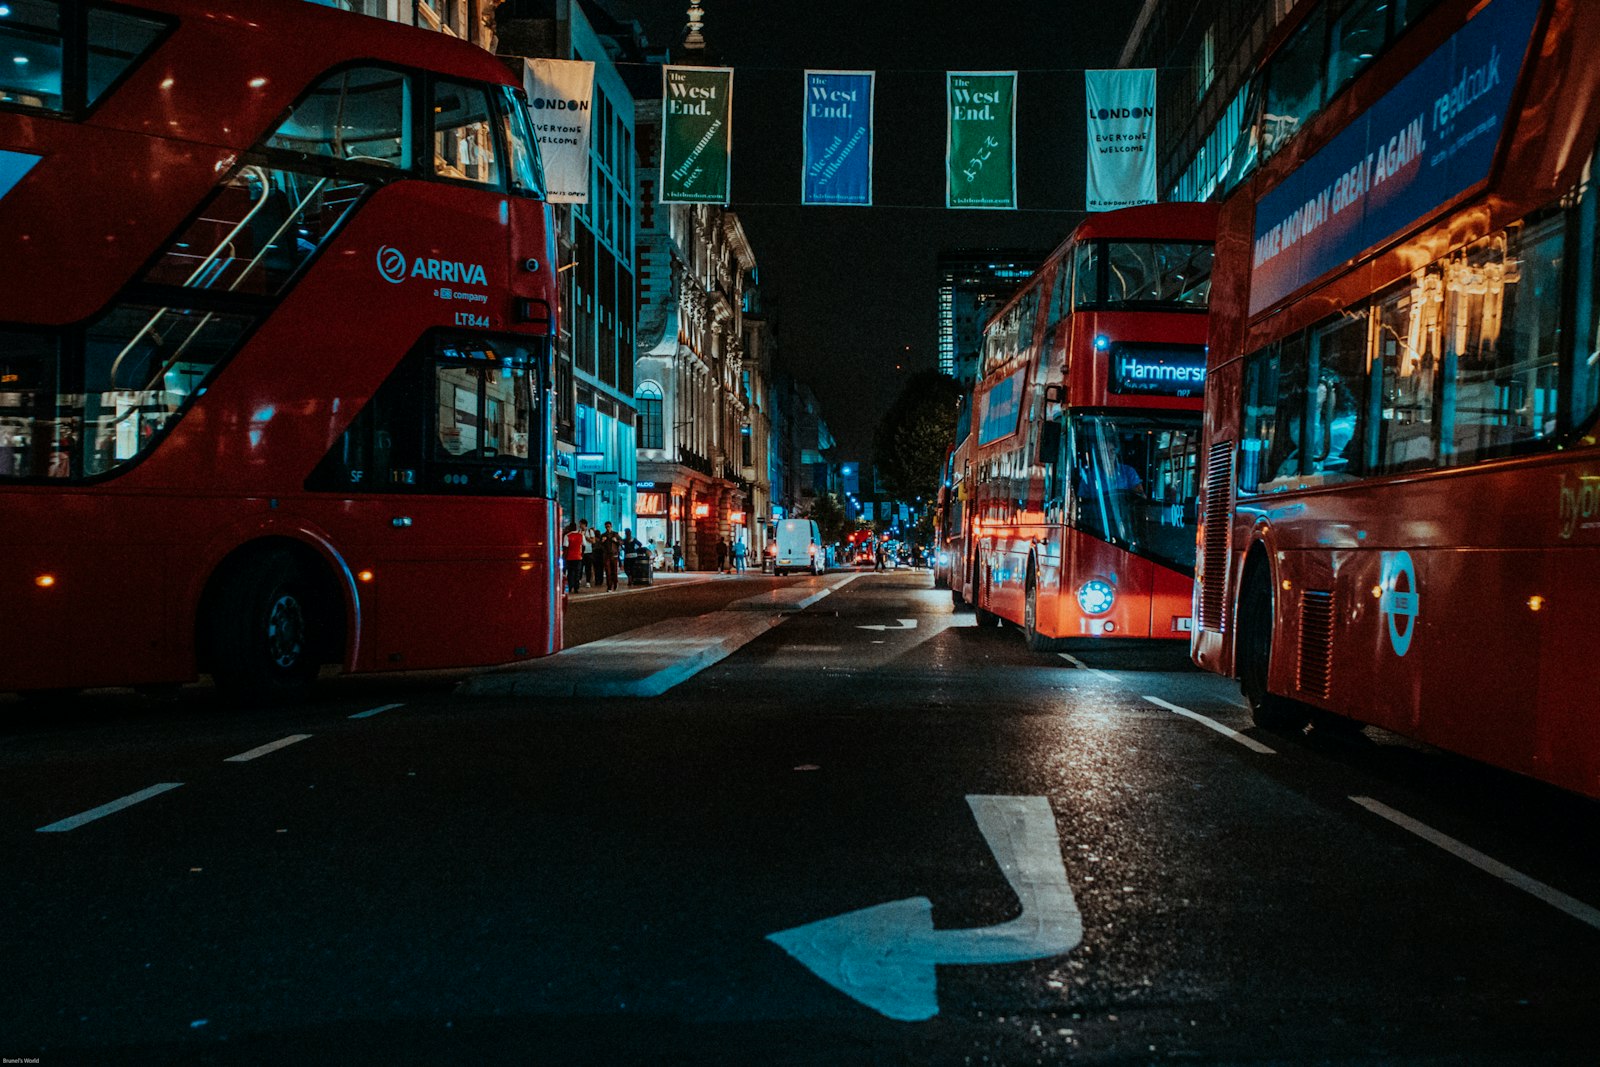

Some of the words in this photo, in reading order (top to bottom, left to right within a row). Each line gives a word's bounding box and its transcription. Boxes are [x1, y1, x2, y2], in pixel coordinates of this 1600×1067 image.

[670, 83, 716, 99] West
[812, 87, 857, 102] West
[954, 89, 1000, 104] West
[670, 99, 712, 116] End.
[811, 103, 852, 119] End.
[954, 105, 995, 120] End.
[1090, 107, 1153, 120] LONDON
[1096, 132, 1147, 142] EVERYONE
[809, 159, 827, 177] Alle
[824, 135, 842, 159] sind
[819, 126, 866, 185] willkommen
[1100, 145, 1143, 153] WELCOME
[963, 135, 999, 182] ようこそ
[1254, 223, 1281, 270] MAKE
[1281, 185, 1331, 251] MONDAY
[1332, 152, 1374, 215] GREAT
[1374, 112, 1426, 187] AGAIN.
[410, 257, 489, 287] ARRIVA
[453, 291, 488, 304] company
[455, 312, 490, 329] LT844
